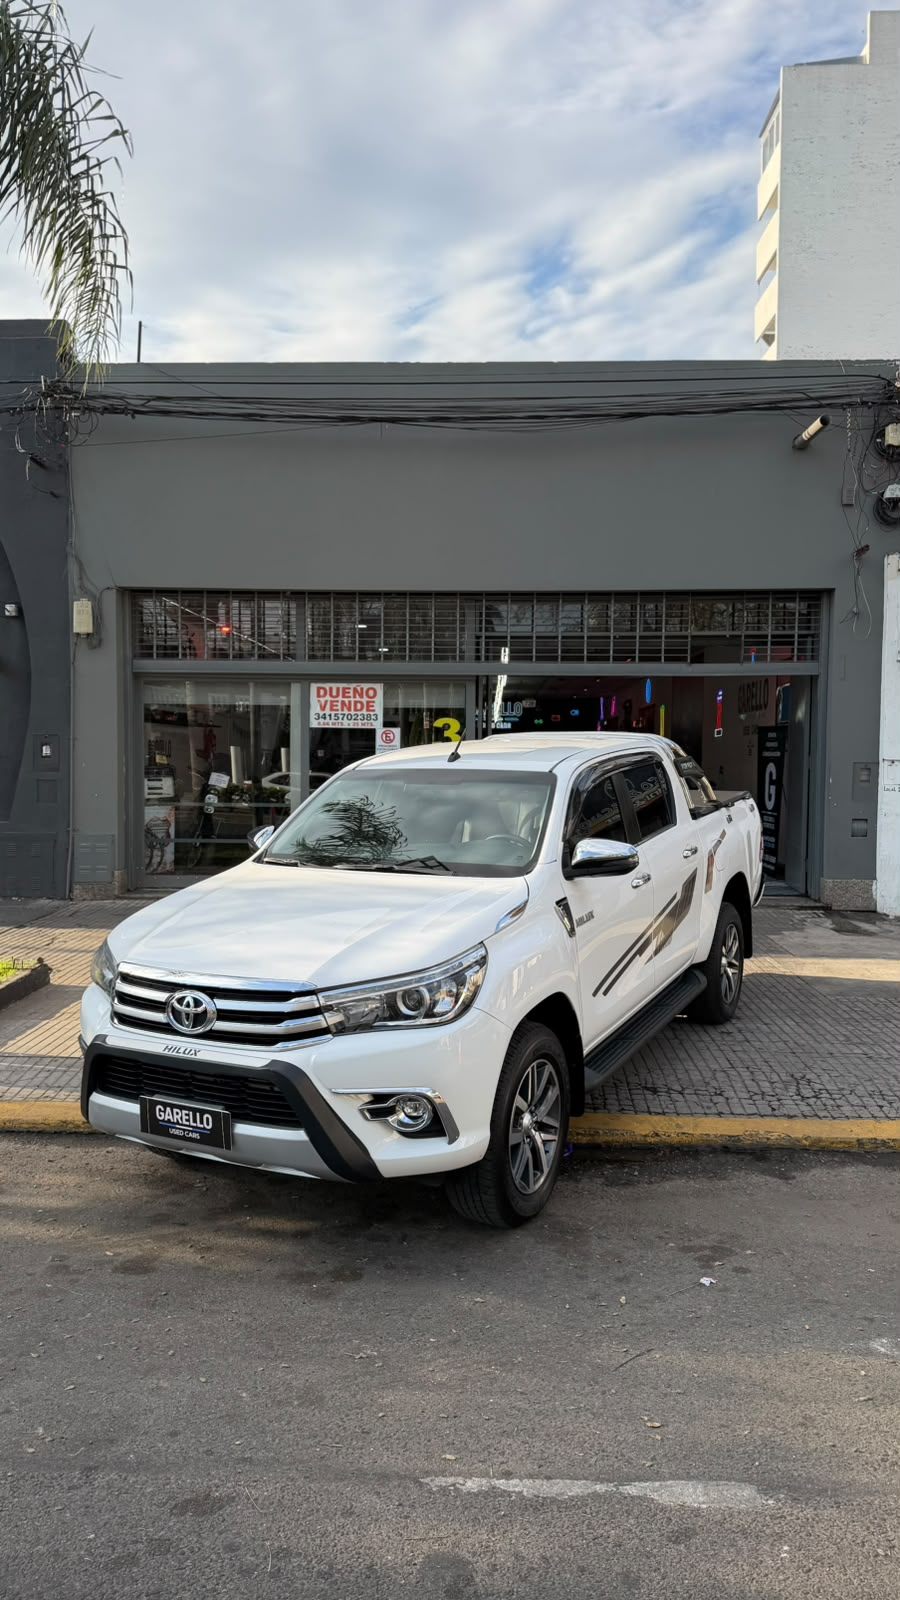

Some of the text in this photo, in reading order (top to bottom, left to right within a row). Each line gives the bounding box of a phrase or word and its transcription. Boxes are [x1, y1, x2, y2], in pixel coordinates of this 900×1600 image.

[316, 685, 378, 699] DUEÑO
[318, 700, 376, 712] VENDE
[314, 712, 378, 721] 3415702383
[764, 762, 777, 810] G
[162, 1045, 201, 1056] HILUX
[155, 1105, 212, 1129] GARELLO
[169, 1128, 201, 1139] USED CARS
